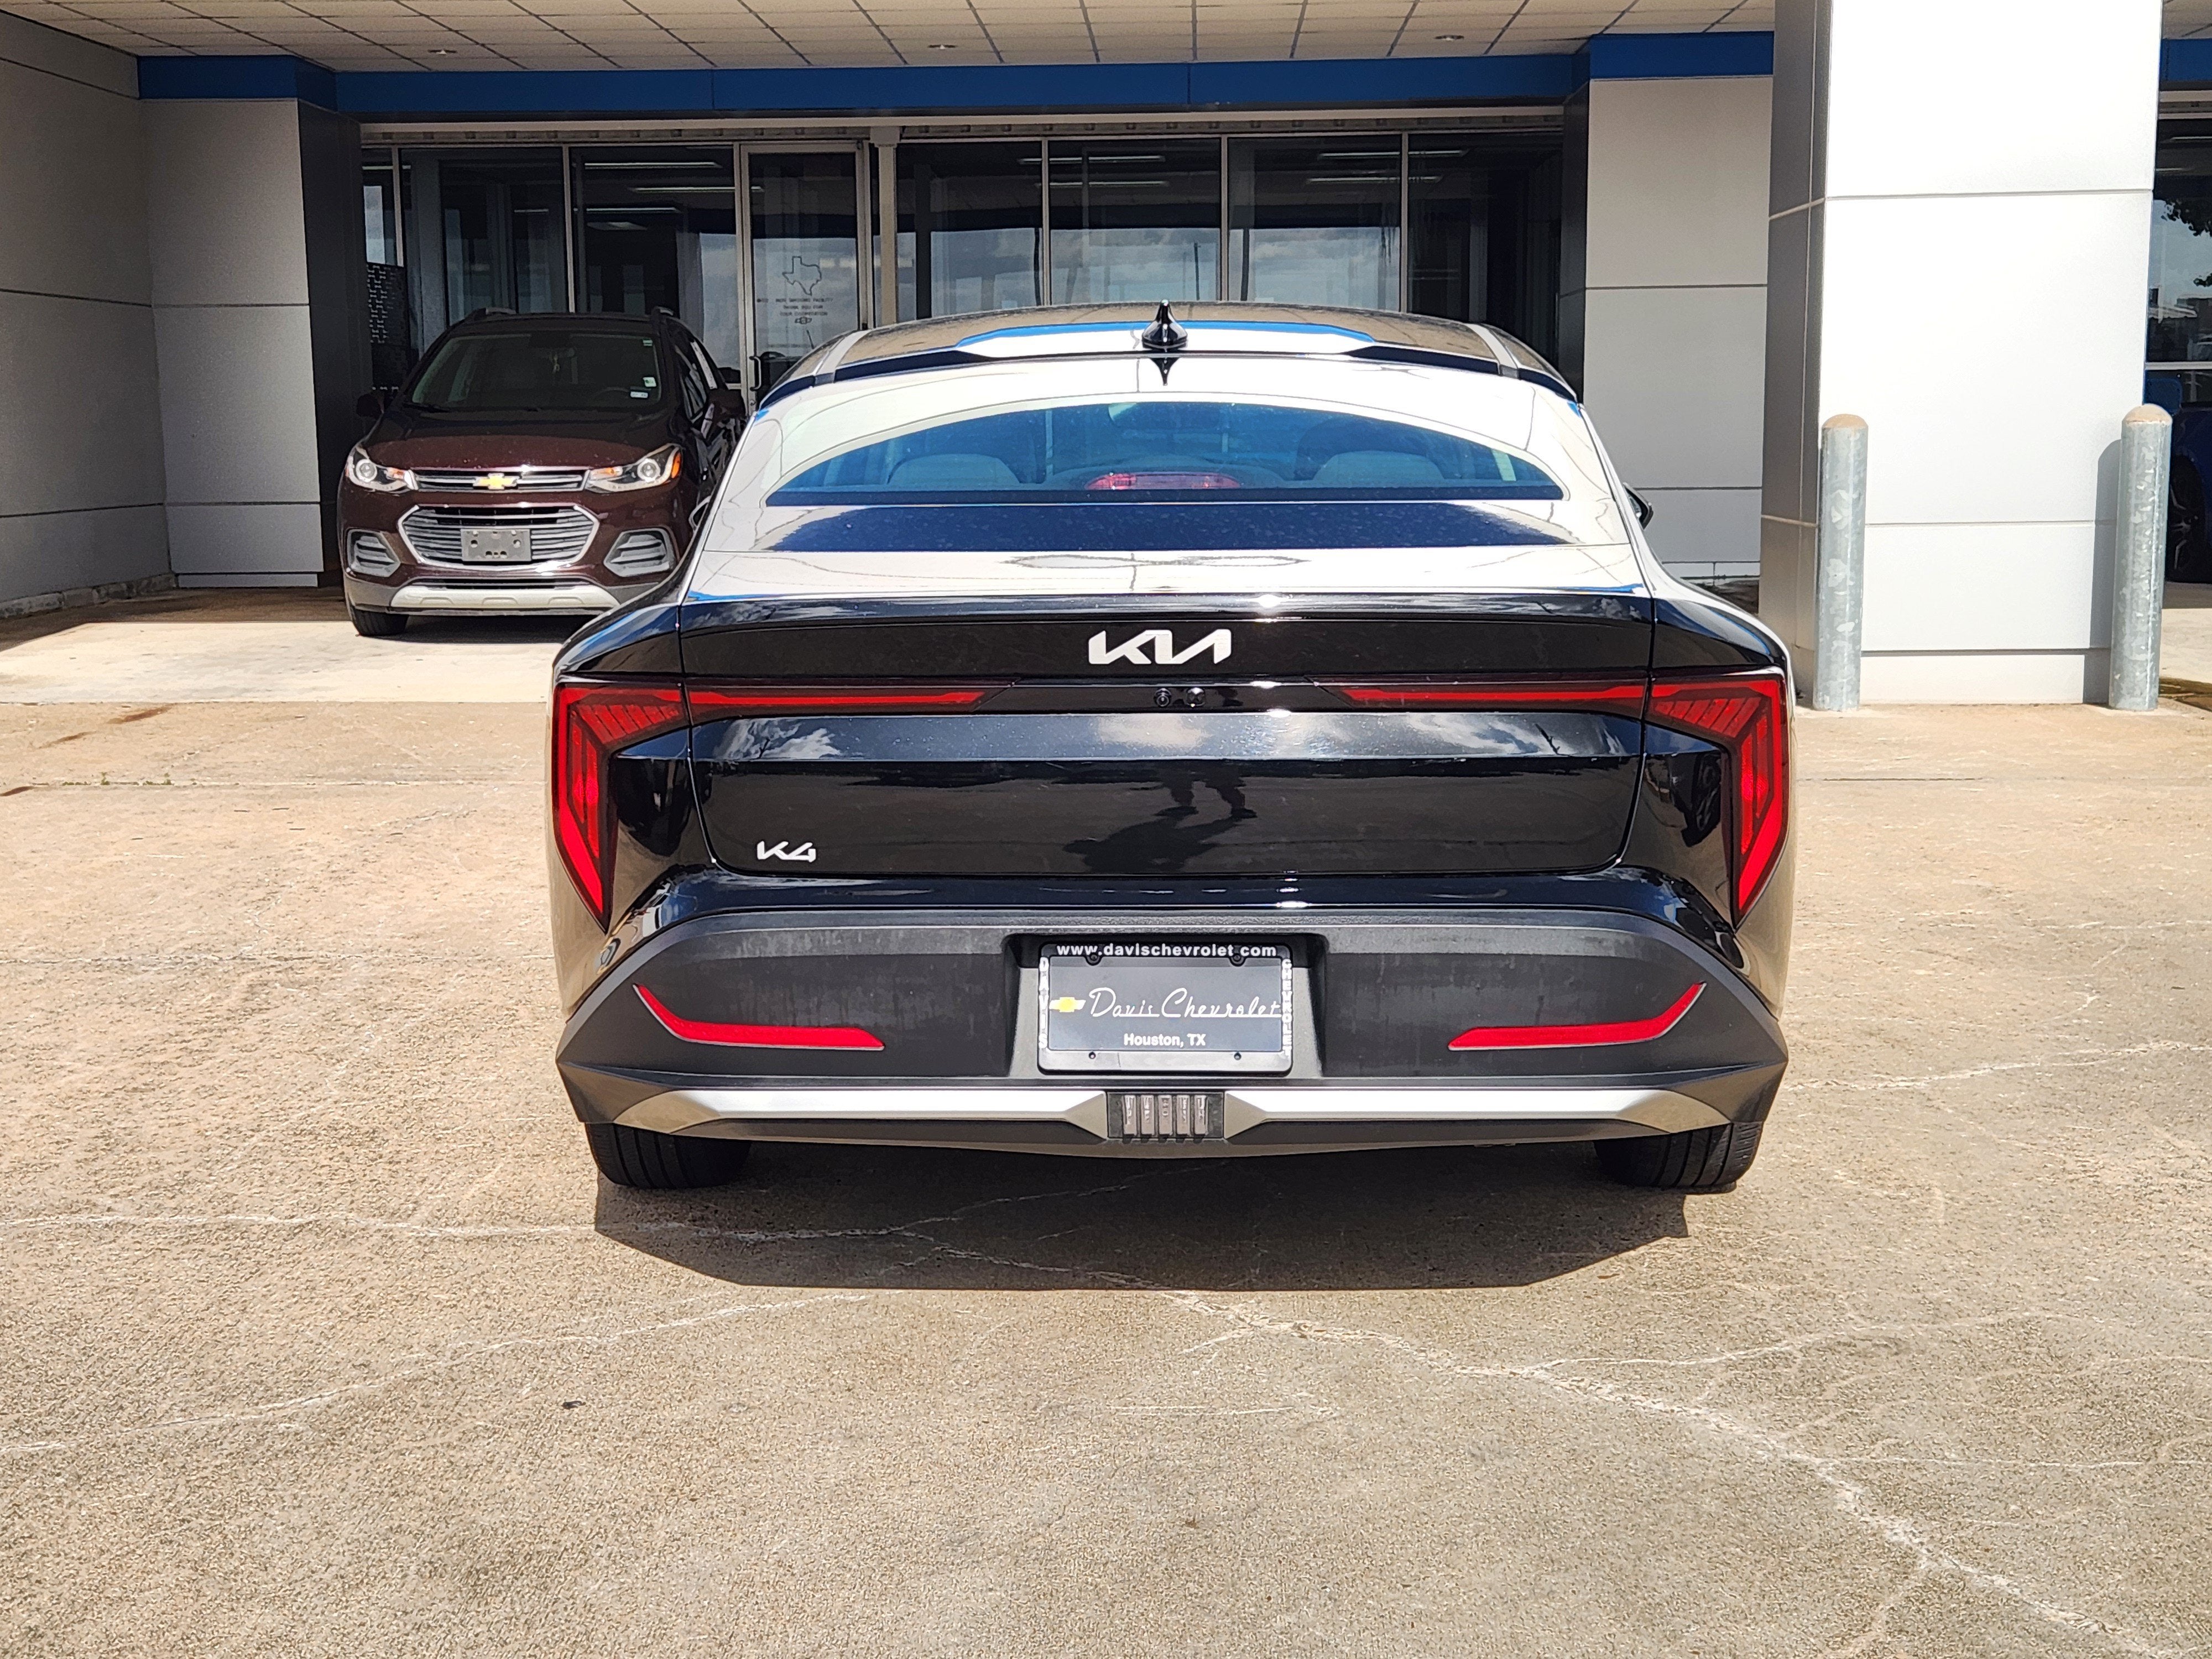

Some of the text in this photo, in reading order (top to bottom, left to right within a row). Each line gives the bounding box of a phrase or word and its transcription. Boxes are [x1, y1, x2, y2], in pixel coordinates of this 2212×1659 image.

[1088, 629, 1232, 664] KIA
[757, 841, 816, 862] K4
[1057, 943, 1276, 957] www.davischevroletcom
[1039, 957, 1050, 1048] DAVIS
[1089, 987, 1282, 1018] Davis Chevrolet
[1282, 958, 1292, 1056] CHEVROLET
[1124, 1033, 1206, 1047] Houston, TX
